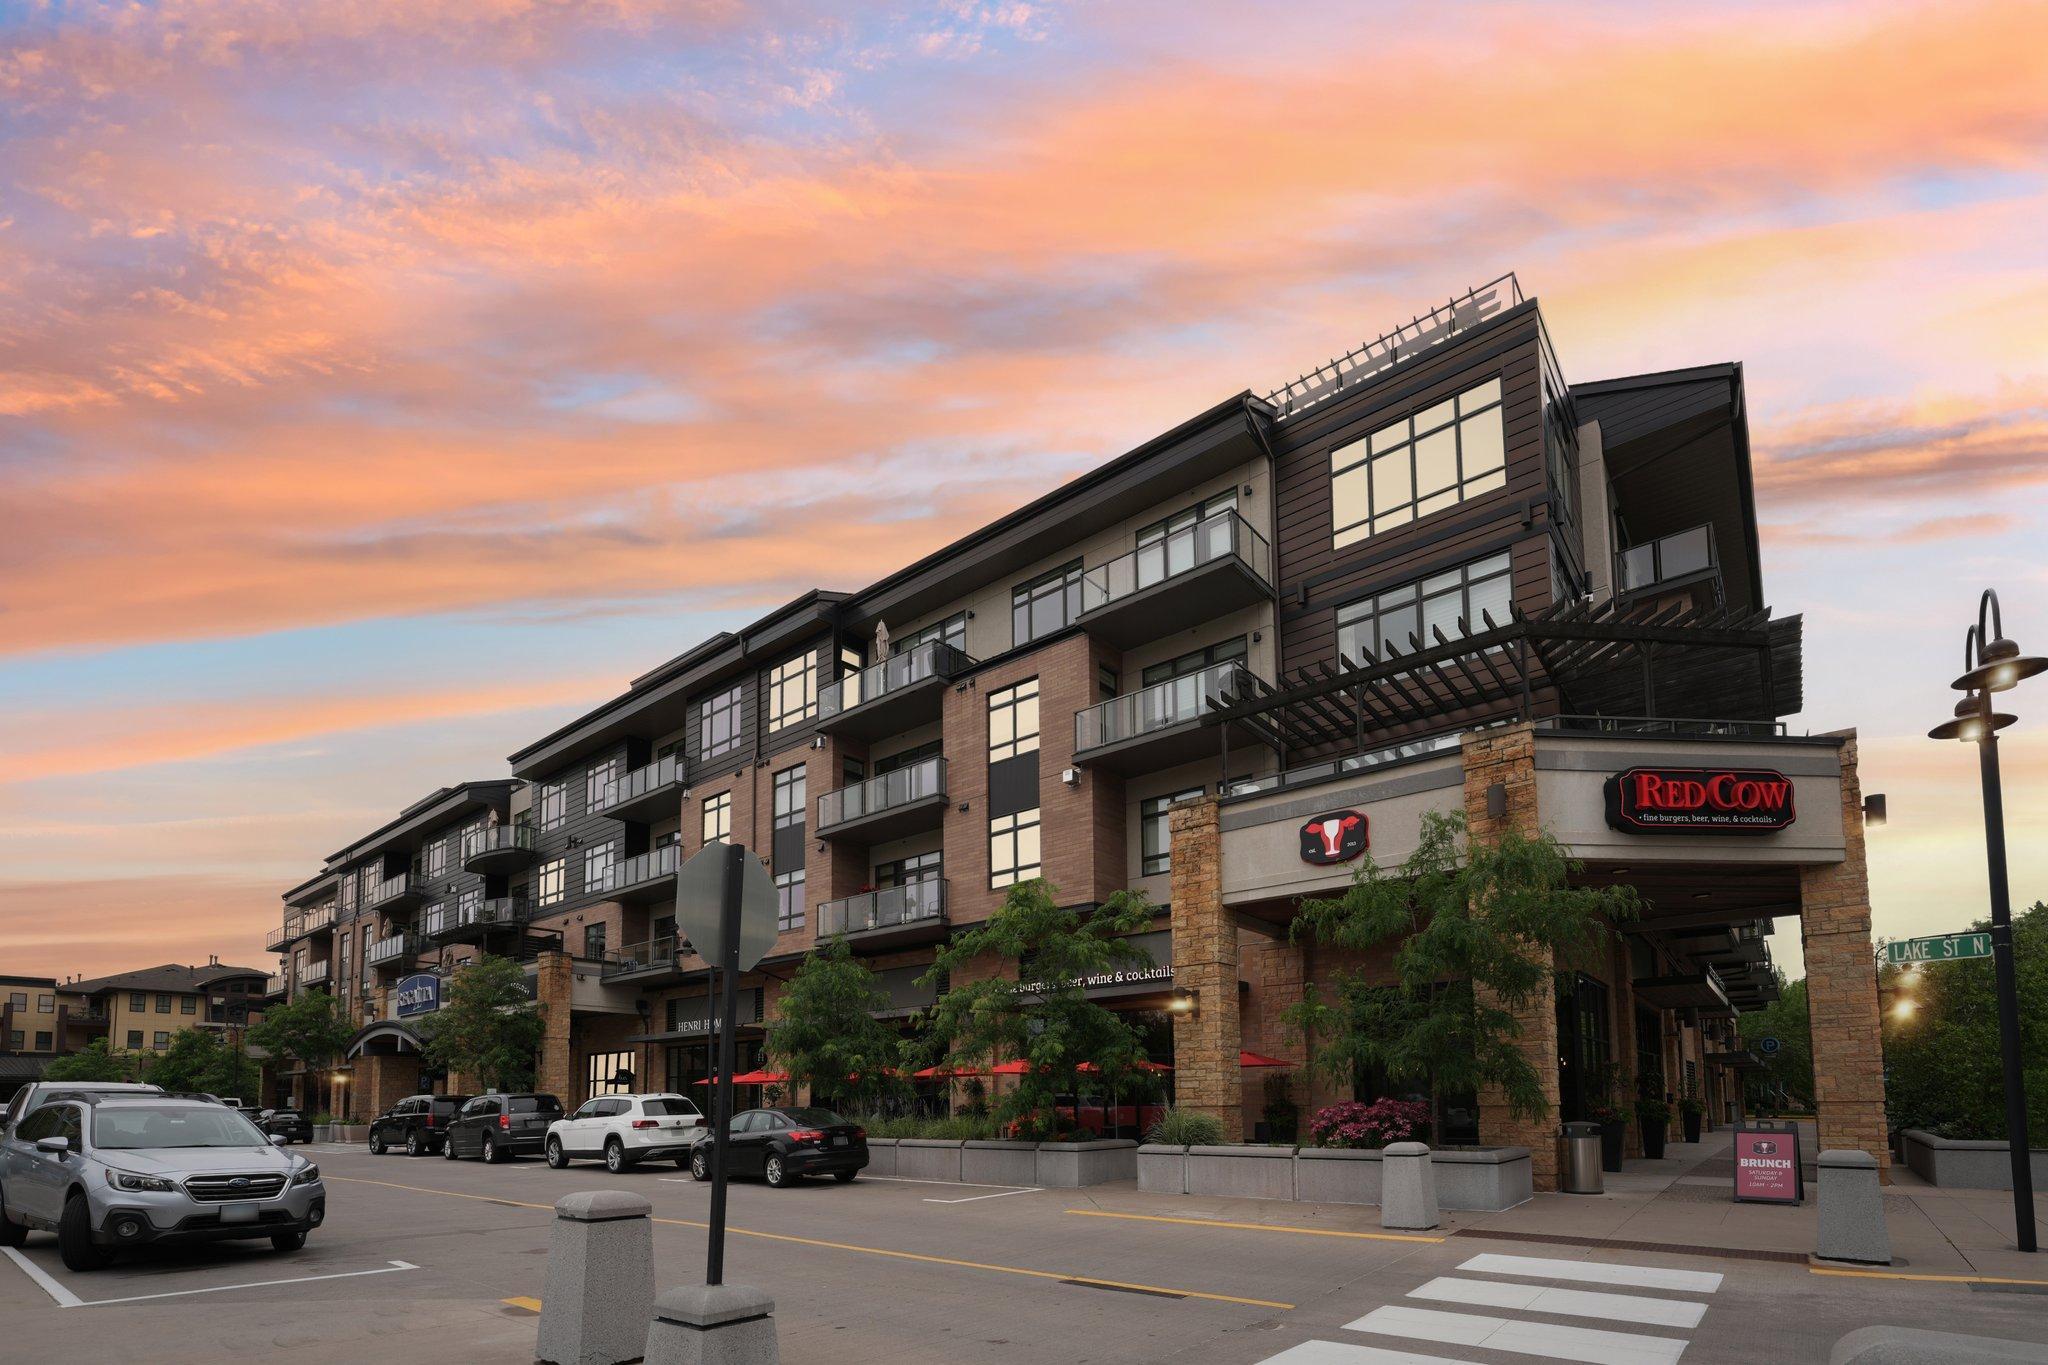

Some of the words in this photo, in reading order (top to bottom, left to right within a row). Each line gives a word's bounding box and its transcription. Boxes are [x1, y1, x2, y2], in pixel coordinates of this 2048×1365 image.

[1643, 813, 1658, 821] fine
[1659, 813, 1691, 824] burgers,
[1691, 814, 1710, 823] beer,
[1711, 815, 1732, 823] wine,
[1732, 815, 1739, 823] &
[1739, 815, 1773, 823] cocktails
[1894, 941, 1931, 961] LAKE
[1942, 938, 1960, 957] ST
[1973, 936, 1985, 955] N
[1087, 973, 1113, 986] wine
[1115, 971, 1124, 982] &
[1126, 965, 1175, 981] cocktails
[678, 1020, 701, 1032] HENRI
[1740, 1158, 1791, 1169] BRUNCH
